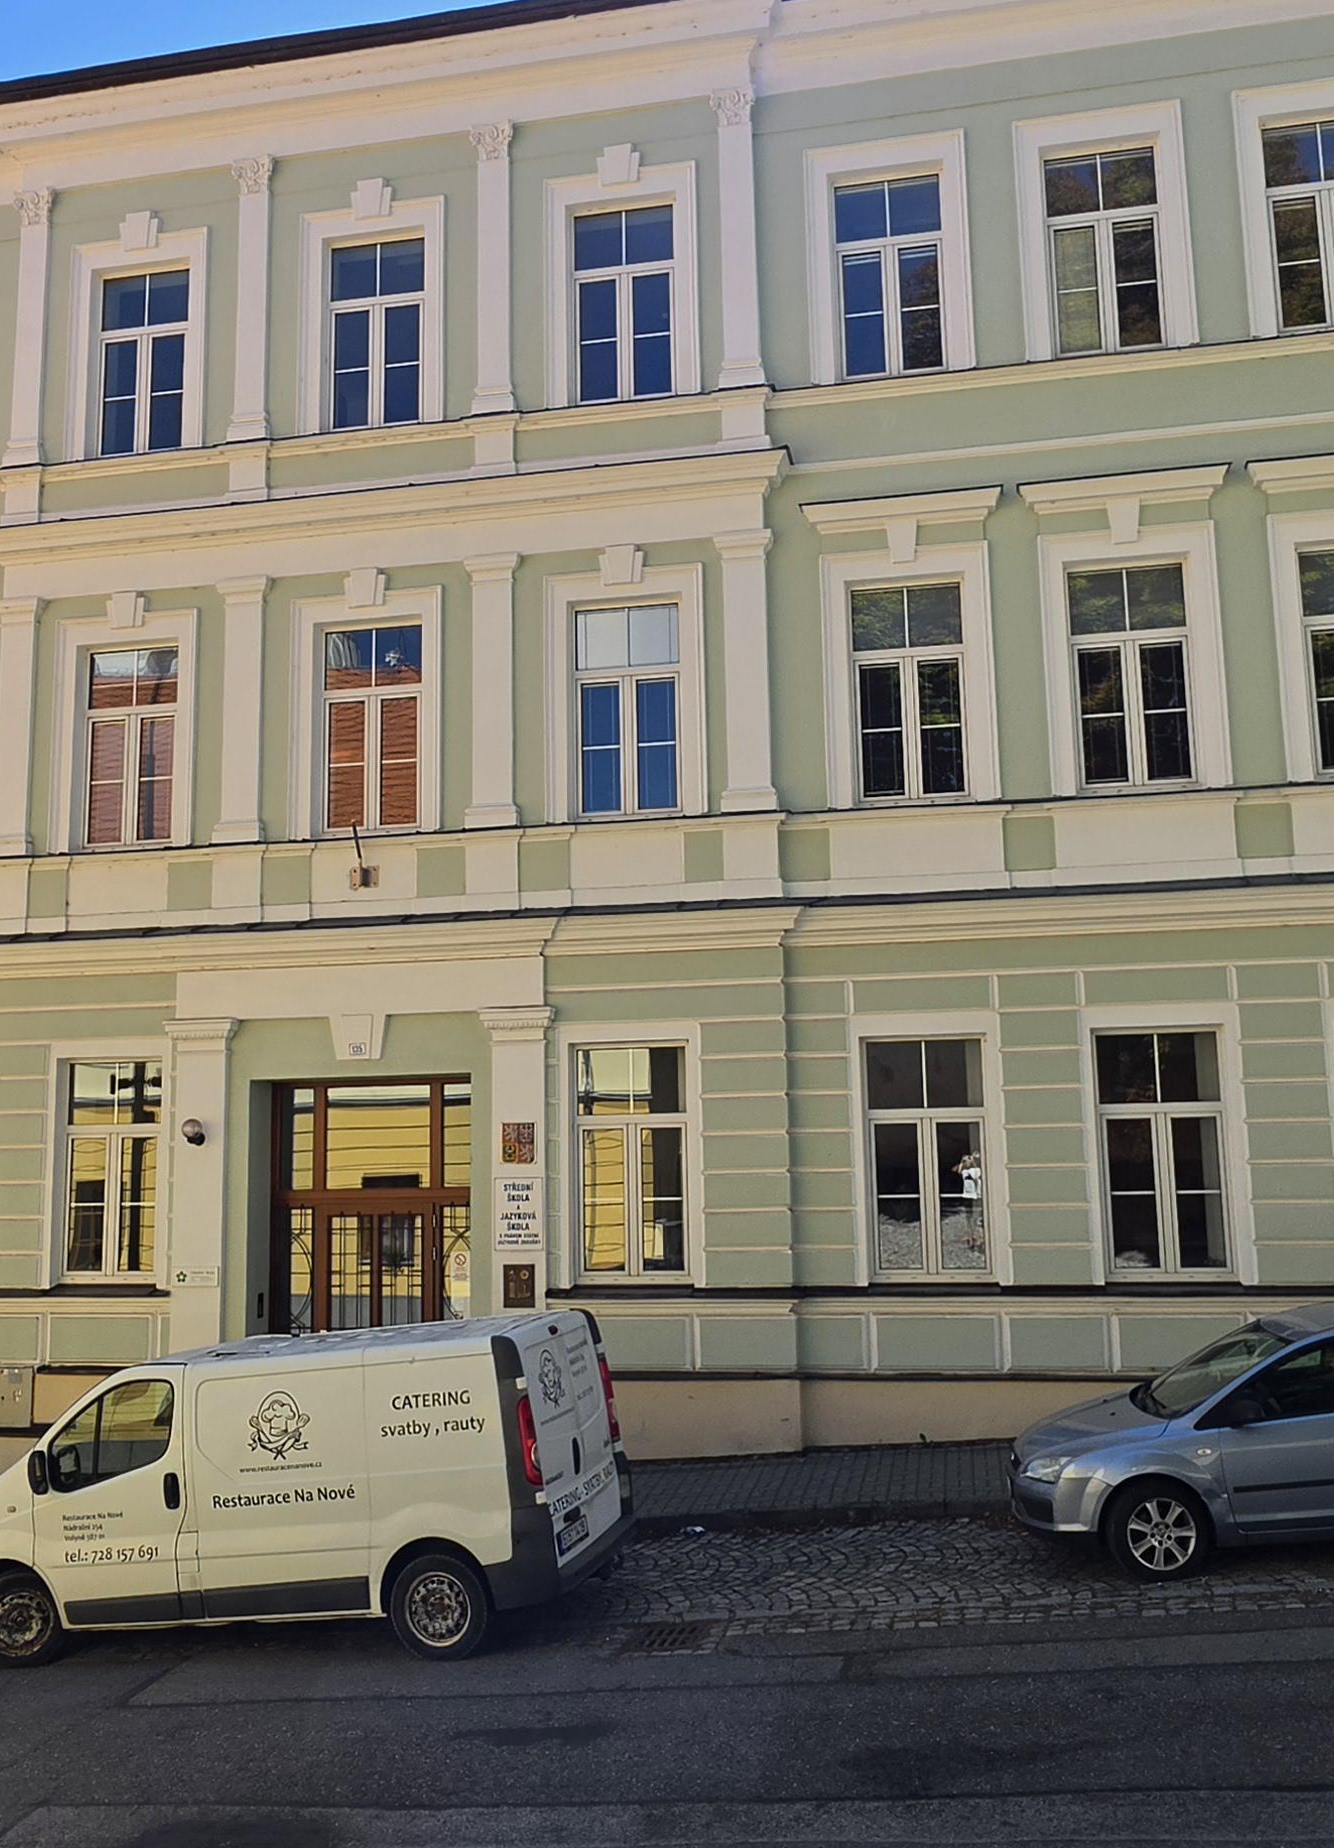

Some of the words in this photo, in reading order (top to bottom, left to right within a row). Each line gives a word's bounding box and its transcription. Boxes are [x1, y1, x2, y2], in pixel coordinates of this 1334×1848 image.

[503, 1181, 534, 1192] STŘEDNÍ
[507, 1193, 530, 1202] ŠKOLA
[500, 1211, 537, 1221] JAZYKOVÁ
[507, 1222, 530, 1231] ŠKOLA
[392, 1390, 471, 1411] CATERING
[380, 1419, 431, 1438] svatby
[444, 1416, 485, 1434] rauty
[239, 1461, 322, 1473] www.restauracenanove.cz
[212, 1491, 291, 1509] Restaurace
[294, 1488, 314, 1503] Na
[317, 1484, 356, 1501] Nové
[65, 1549, 88, 1563] tel.:
[91, 1547, 113, 1564] 728
[117, 1548, 135, 1562] 157
[138, 1545, 159, 1561] 691
